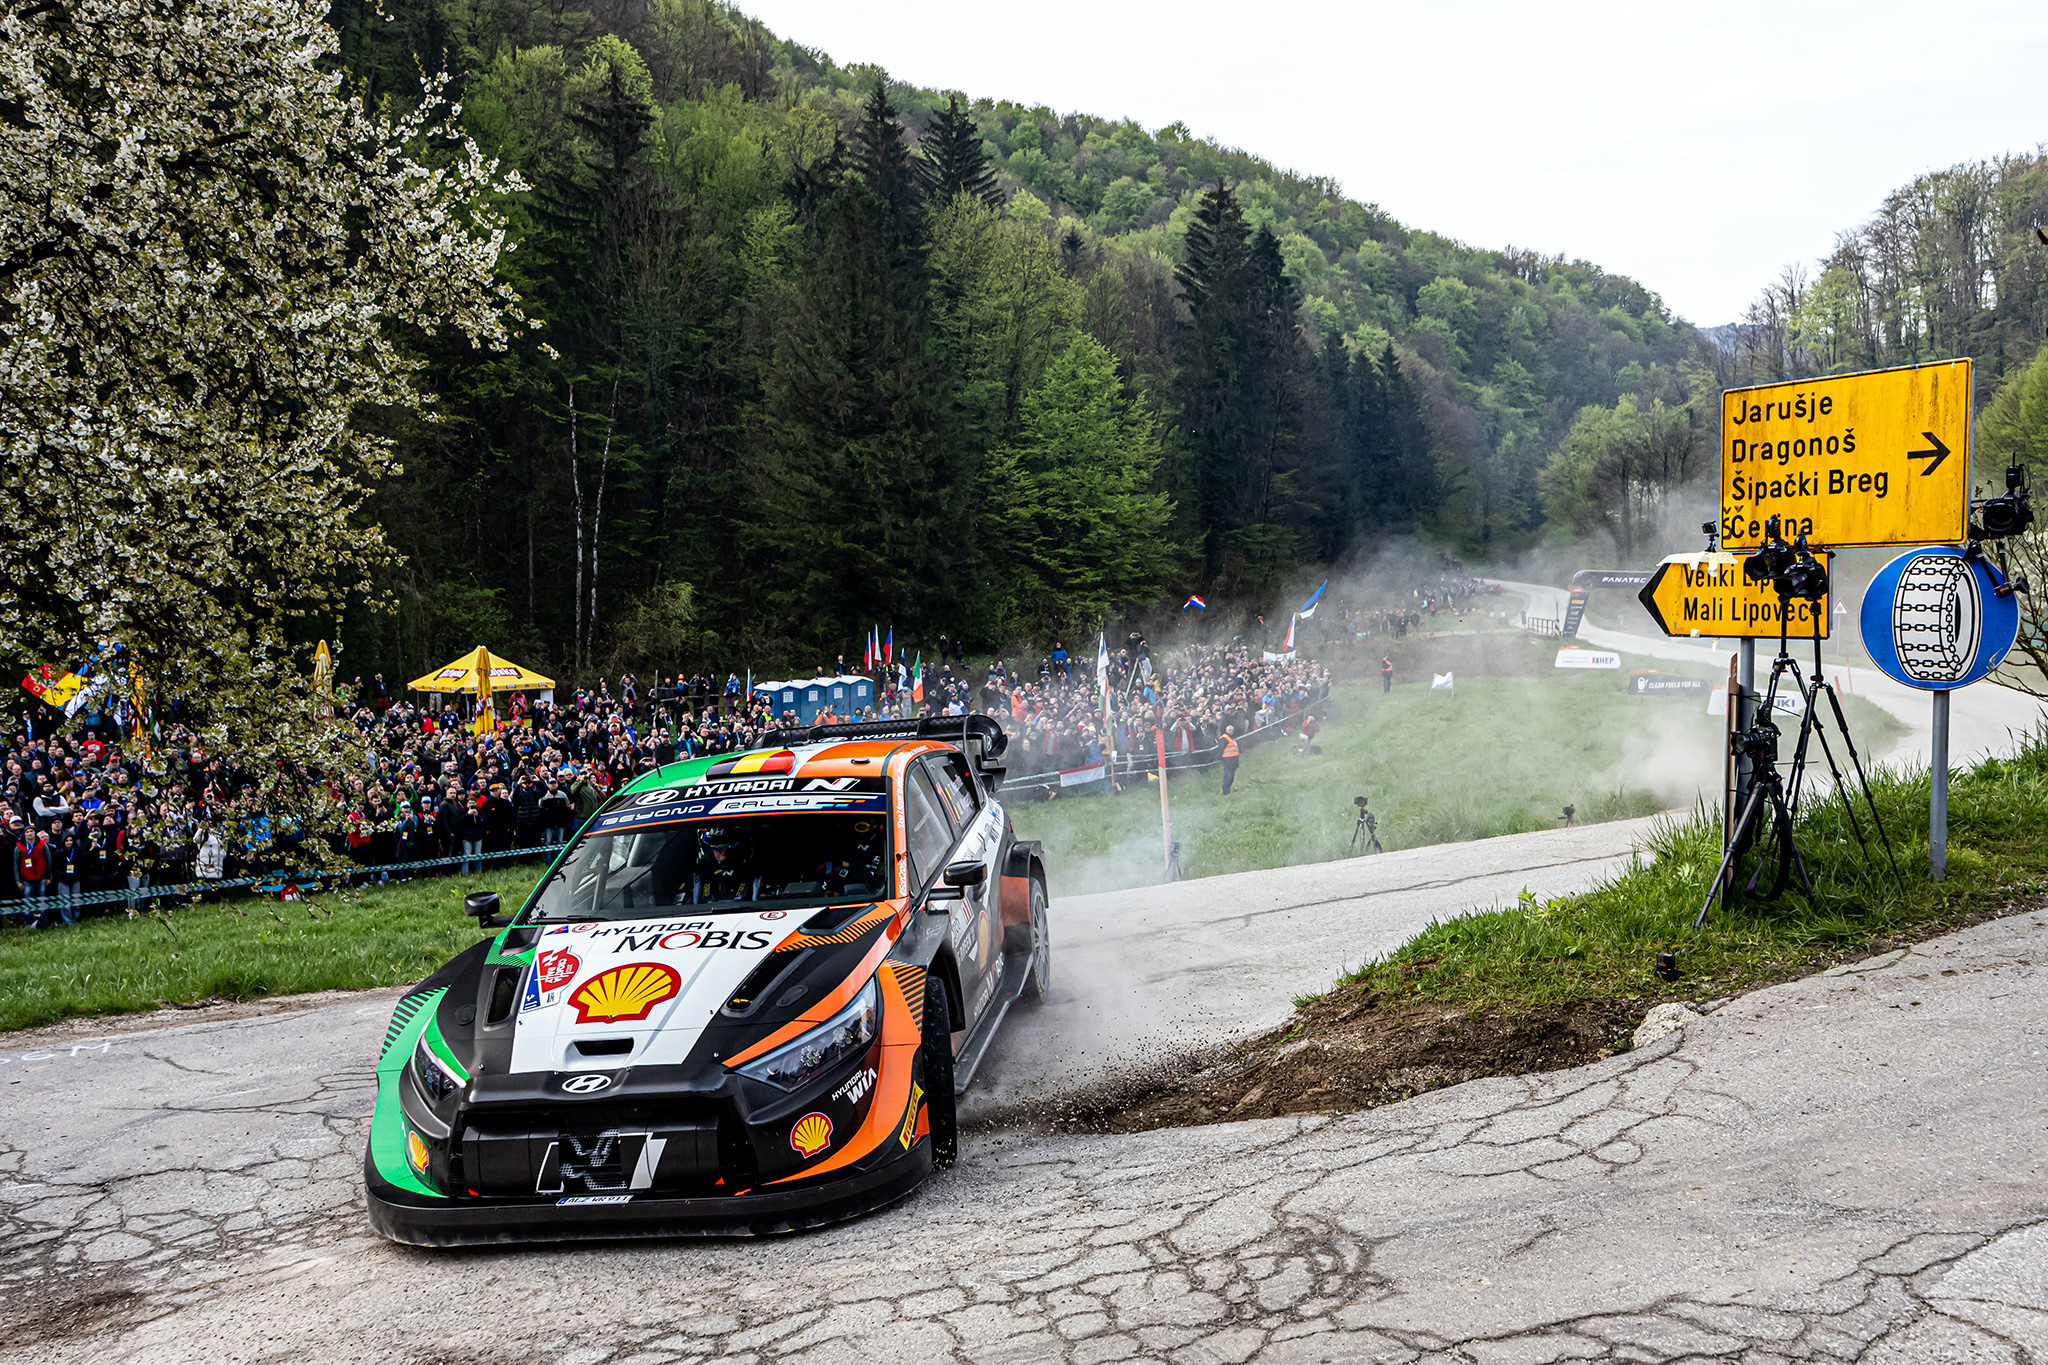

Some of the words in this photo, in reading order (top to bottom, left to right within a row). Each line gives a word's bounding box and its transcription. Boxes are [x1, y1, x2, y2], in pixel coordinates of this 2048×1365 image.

[1732, 392, 1833, 425] Jarušje
[1732, 428, 1856, 466] Dragonoš
[1731, 470, 1818, 506] Šipački
[1828, 469, 1888, 498] Breg
[1601, 576, 1647, 584] FANATEC
[1683, 597, 1723, 621] Mali
[684, 779, 794, 798] HYUNDAI
[602, 804, 704, 826] BEYOND
[724, 798, 810, 810] RALLY
[590, 921, 714, 939] HYUNDAI
[612, 930, 772, 953] MOBIS
[831, 1070, 863, 1101] HYUNDAI
